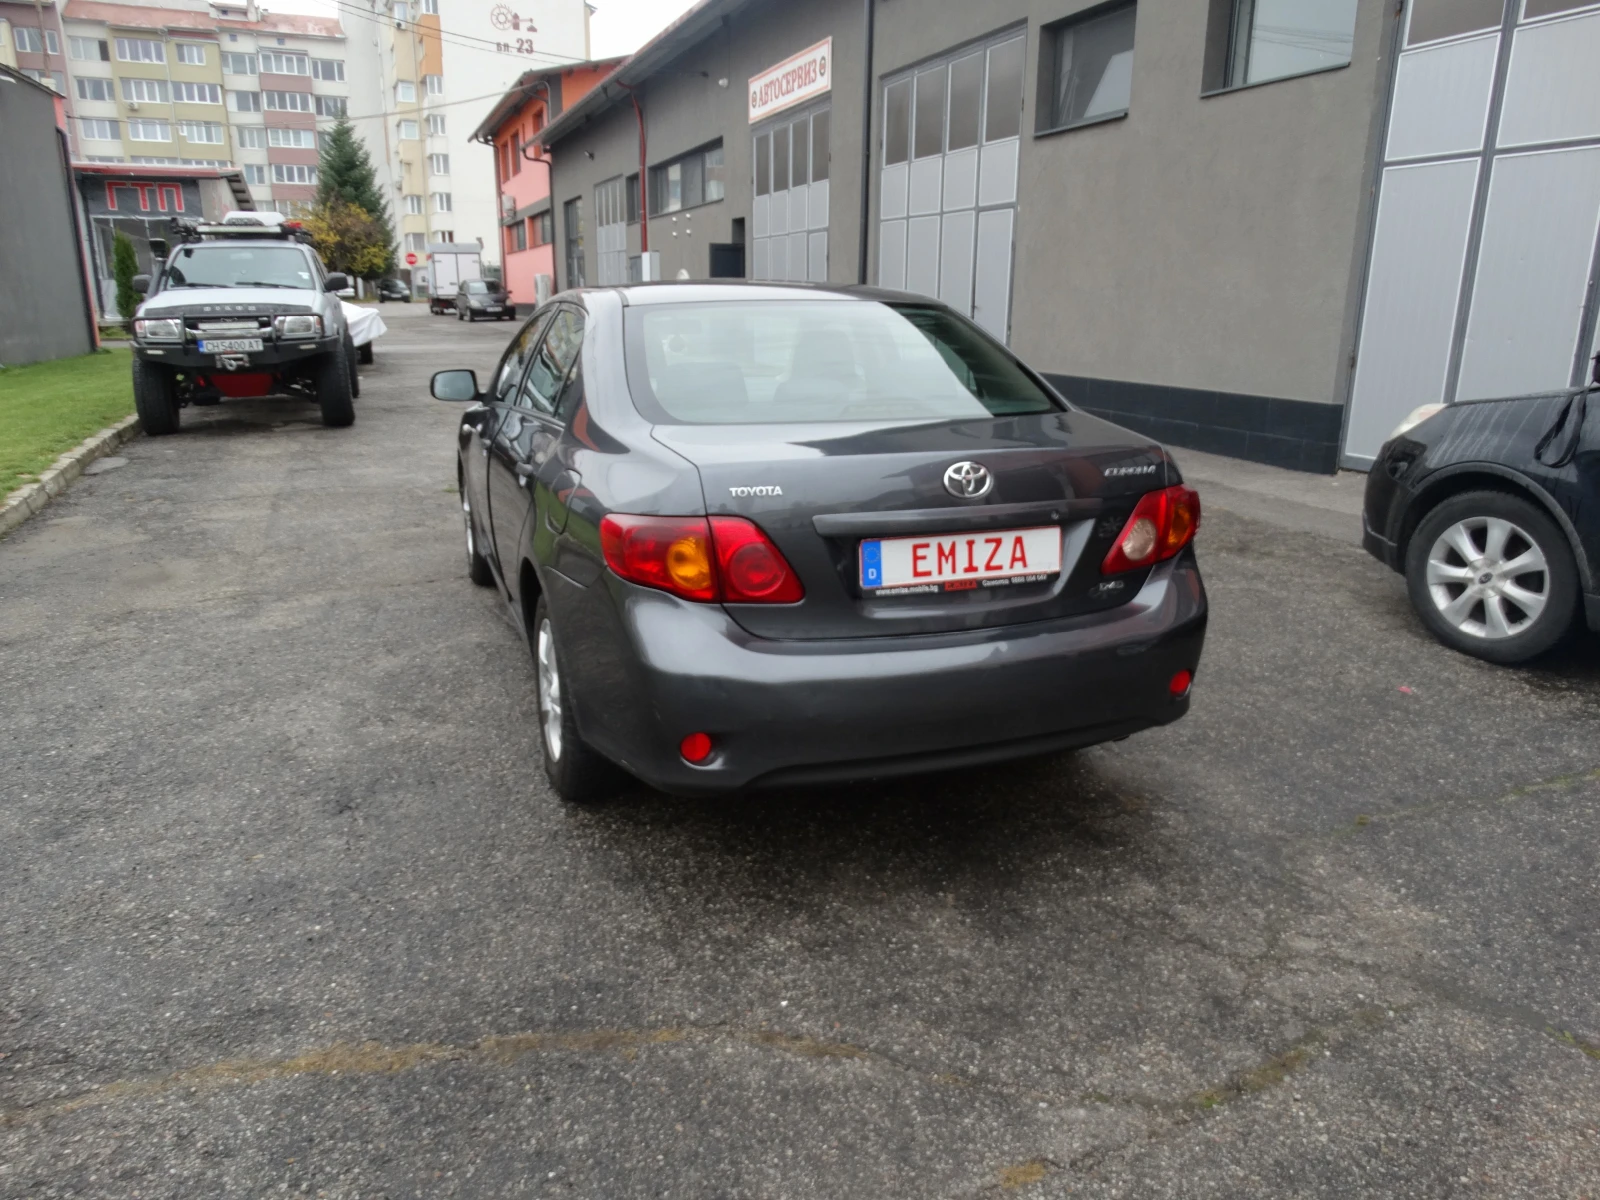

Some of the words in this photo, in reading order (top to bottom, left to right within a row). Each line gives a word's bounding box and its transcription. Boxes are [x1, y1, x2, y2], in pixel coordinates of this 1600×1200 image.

[516, 38, 534, 54] 23
[758, 58, 817, 108] АВТОСЕРВИЗ
[105, 181, 185, 212] ГТП
[729, 485, 783, 497] TOYOTA
[912, 536, 1028, 578] EMIZA
[868, 568, 877, 579] D
